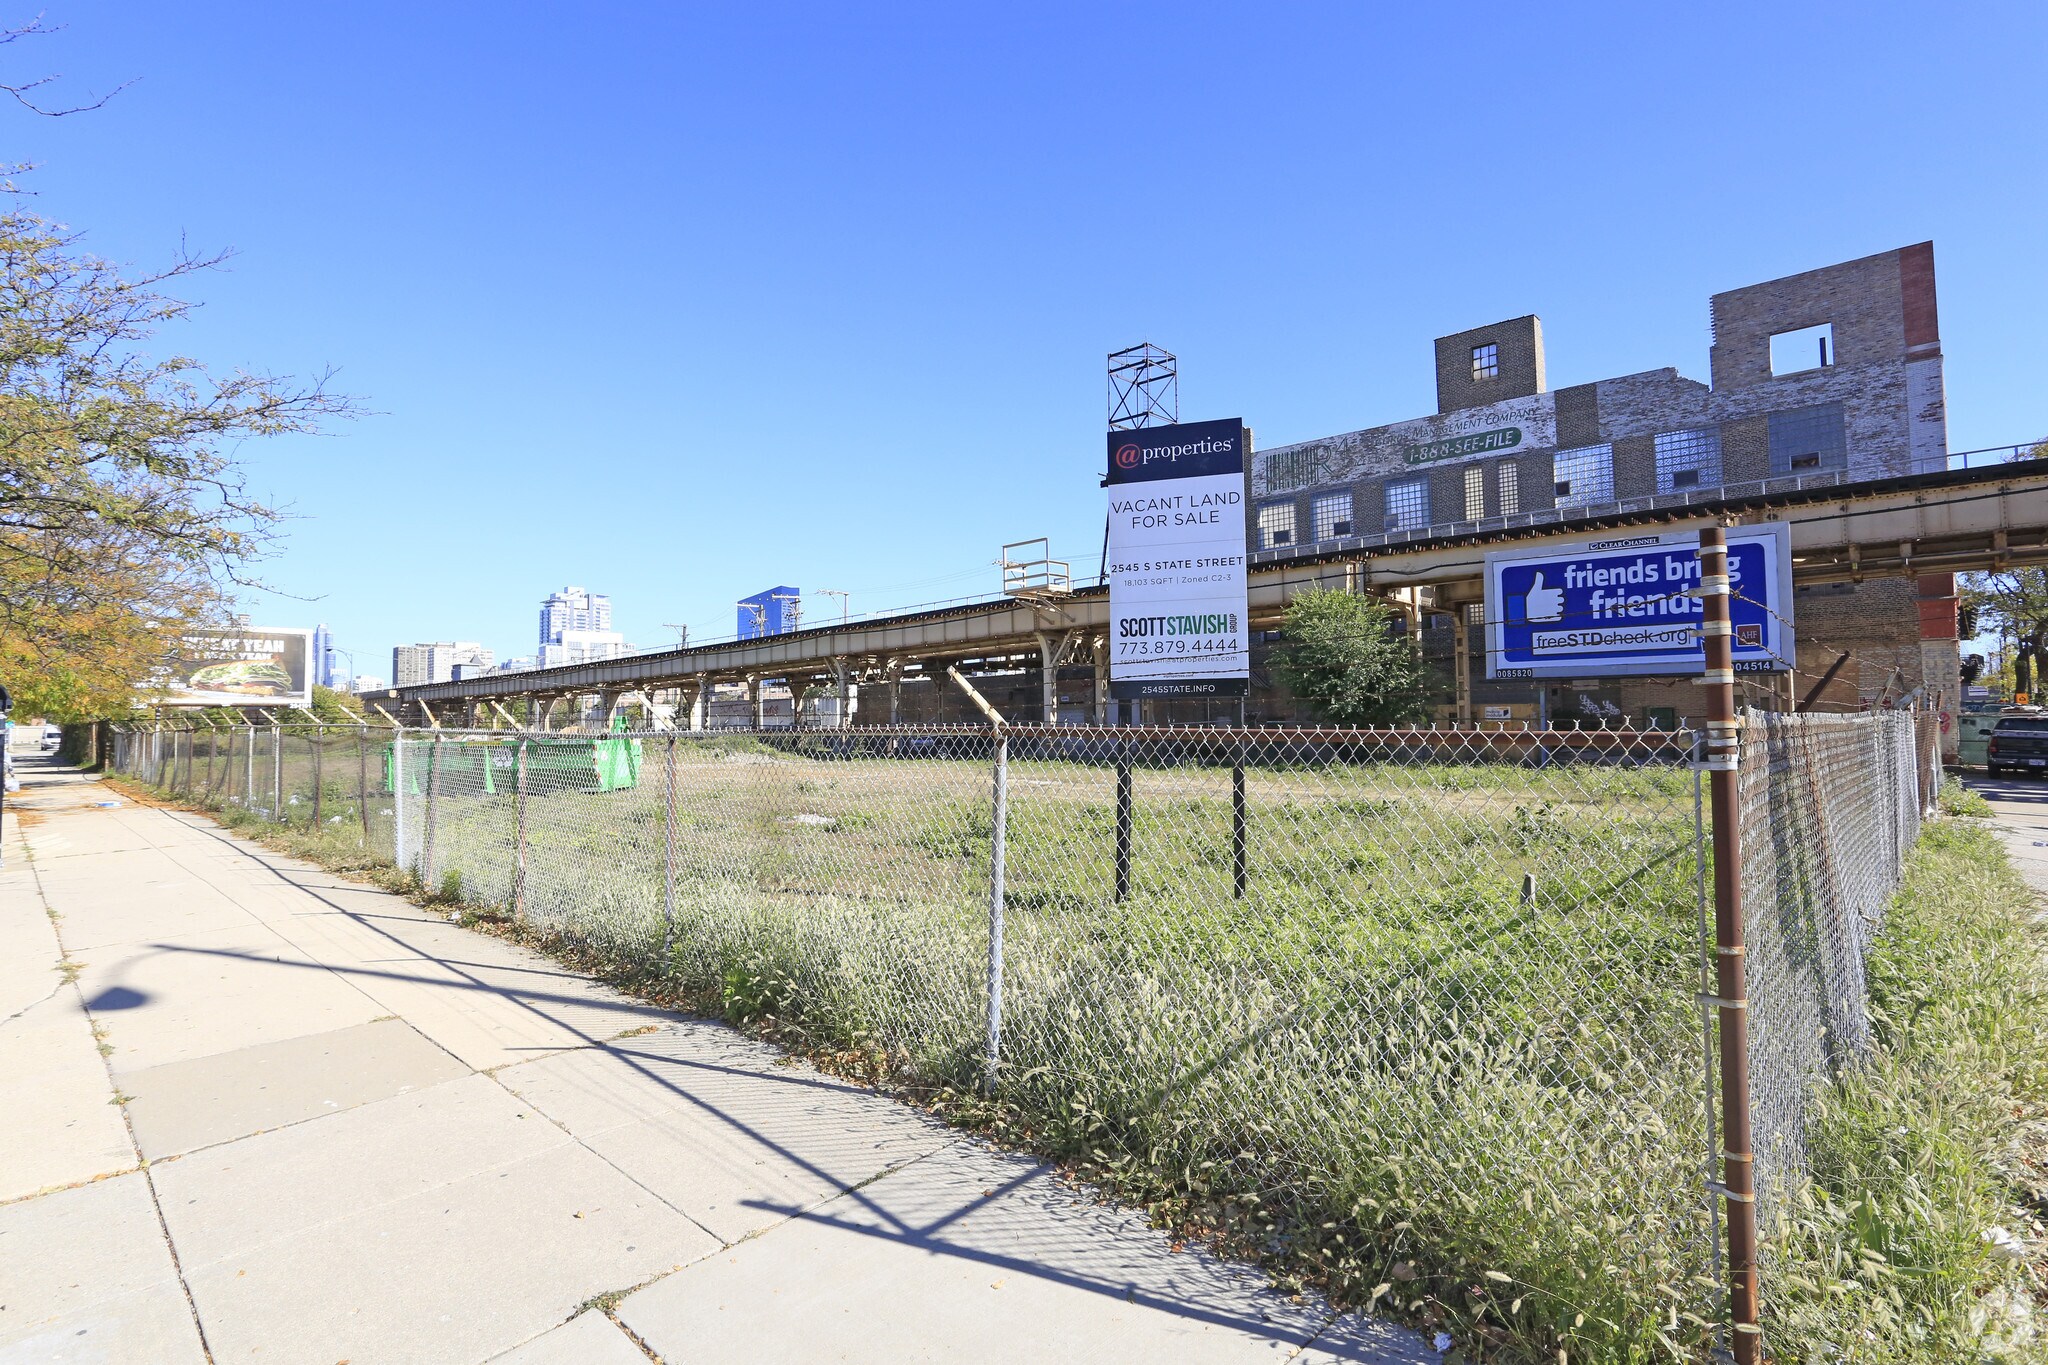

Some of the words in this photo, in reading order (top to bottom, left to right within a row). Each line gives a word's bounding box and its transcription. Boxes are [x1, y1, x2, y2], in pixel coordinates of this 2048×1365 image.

[1412, 419, 1482, 440] MANAGEMENT
[1485, 406, 1541, 426] COMPANY
[1111, 496, 1183, 514] VACANT
[1190, 491, 1241, 508] LAND
[1132, 514, 1168, 529] FOR
[1174, 510, 1220, 526] SALE
[1111, 563, 1140, 573] 2545
[1144, 562, 1151, 571] S
[1155, 560, 1192, 571] STATE
[1196, 556, 1244, 568] STREET
[1564, 558, 1659, 589] friends
[1665, 555, 1742, 583] brig
[1151, 577, 1173, 586] SQFT
[1181, 574, 1209, 584] Zoned
[1211, 574, 1232, 582] C2-3
[1589, 582, 1704, 620] friends
[1229, 613, 1238, 634] GROUP
[1536, 629, 1688, 648] freeSTDcheck.org
[1741, 630, 1758, 639] AHF
[243, 639, 284, 653] YEAH
[1119, 638, 1238, 656] 773.879.4444
[1497, 669, 1532, 678] 0085820
[1142, 684, 1216, 694] 2545STATE.INFO
